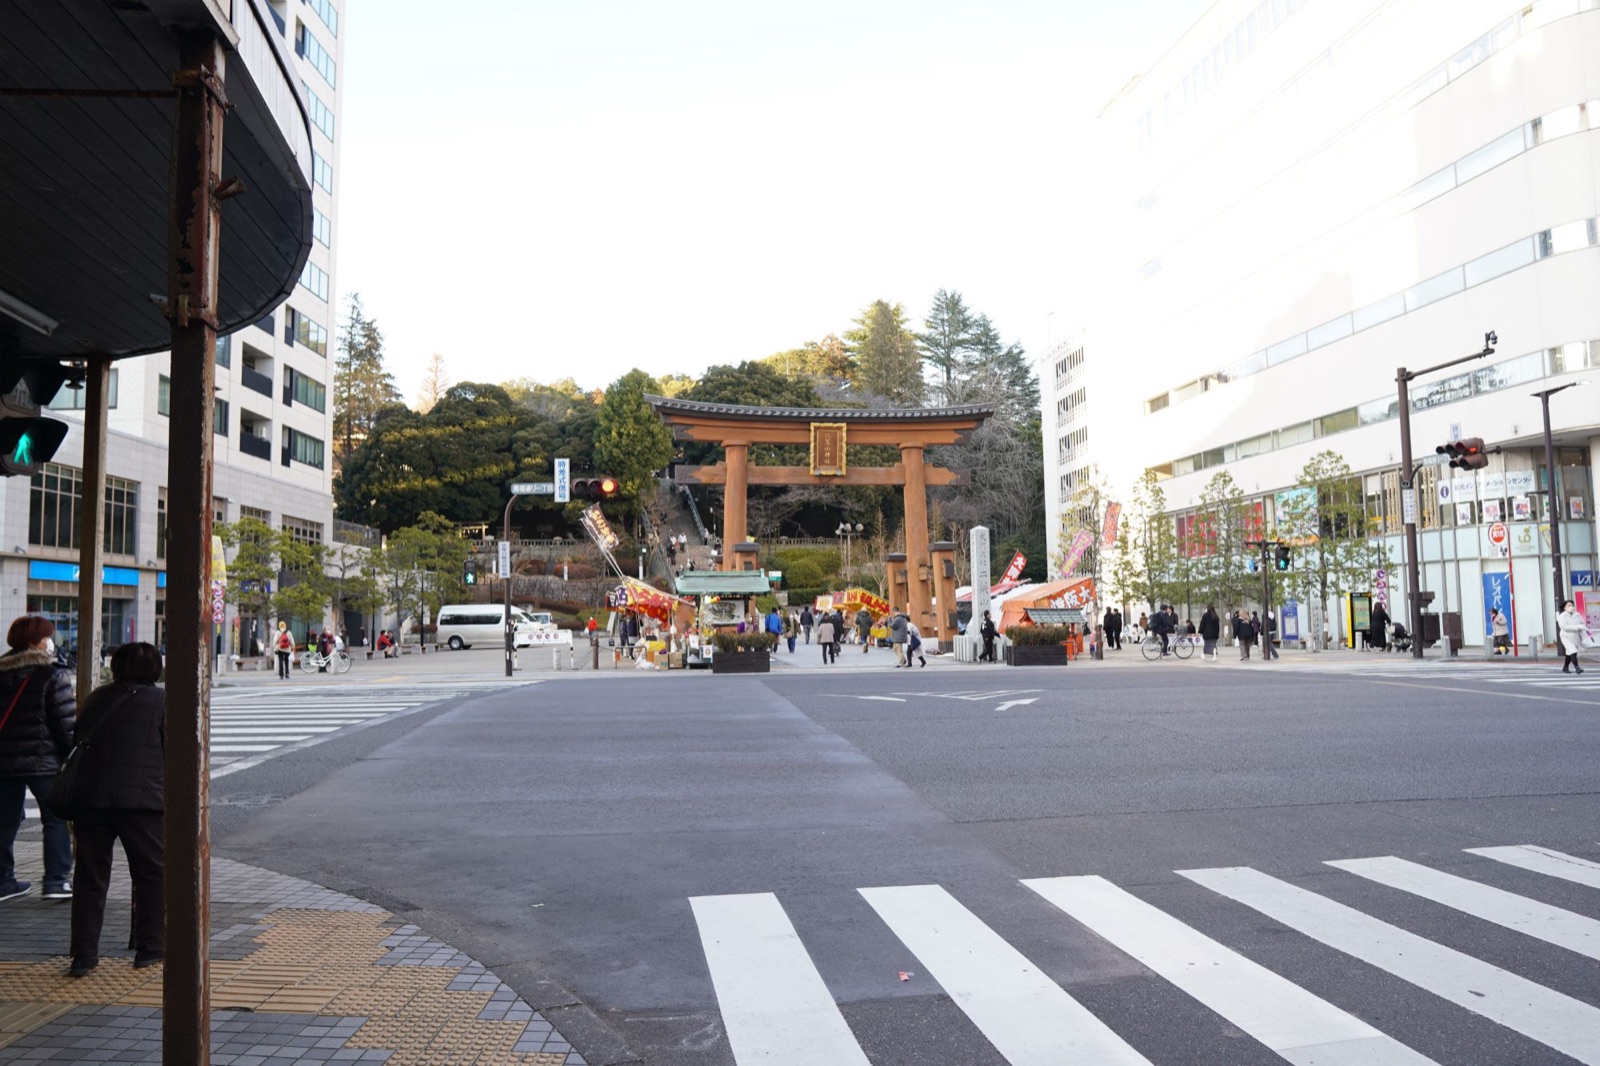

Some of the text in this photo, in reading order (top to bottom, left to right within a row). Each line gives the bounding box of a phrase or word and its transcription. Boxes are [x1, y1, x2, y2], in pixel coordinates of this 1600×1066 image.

[557, 460, 566, 500] 時差式信号
